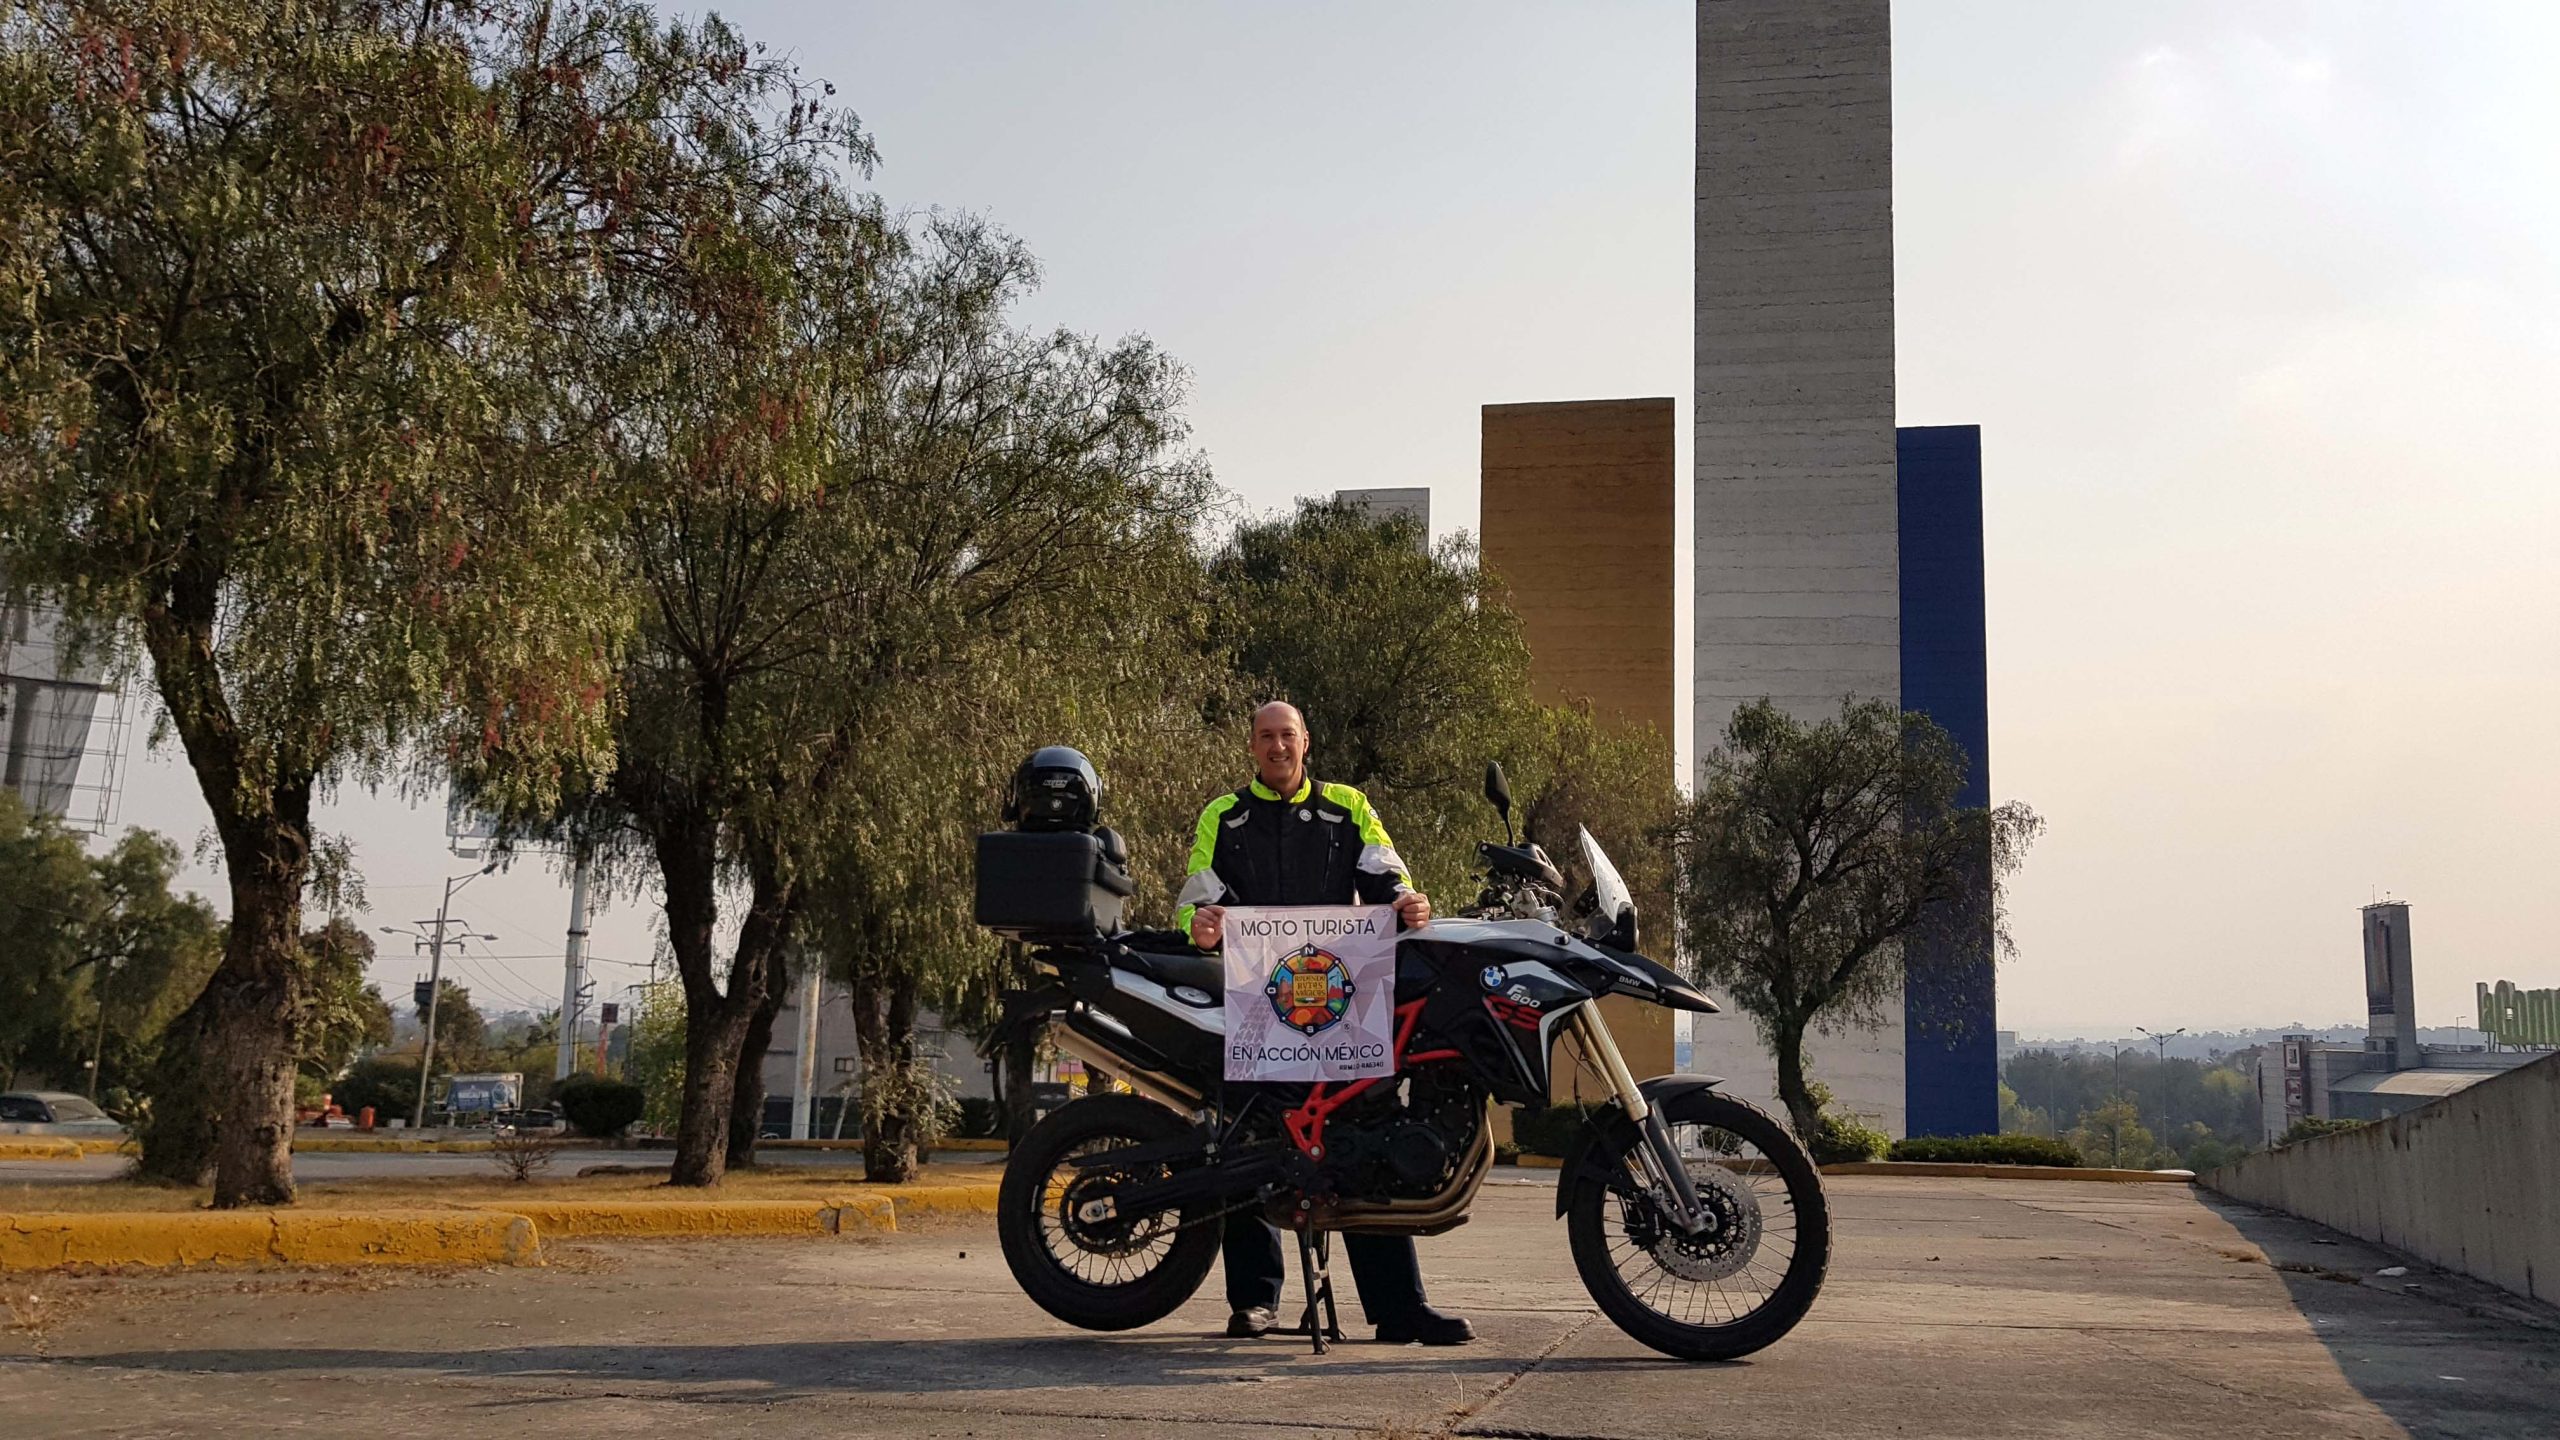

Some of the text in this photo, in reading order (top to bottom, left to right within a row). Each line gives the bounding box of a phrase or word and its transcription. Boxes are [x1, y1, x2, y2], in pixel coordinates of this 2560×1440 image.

[1241, 919, 1376, 936] MOTO TURISTA
[1304, 946, 1314, 954] N
[1618, 975, 1641, 988] BMW
[1232, 1042, 1384, 1062] EN ACCIÓN MÉXICO
